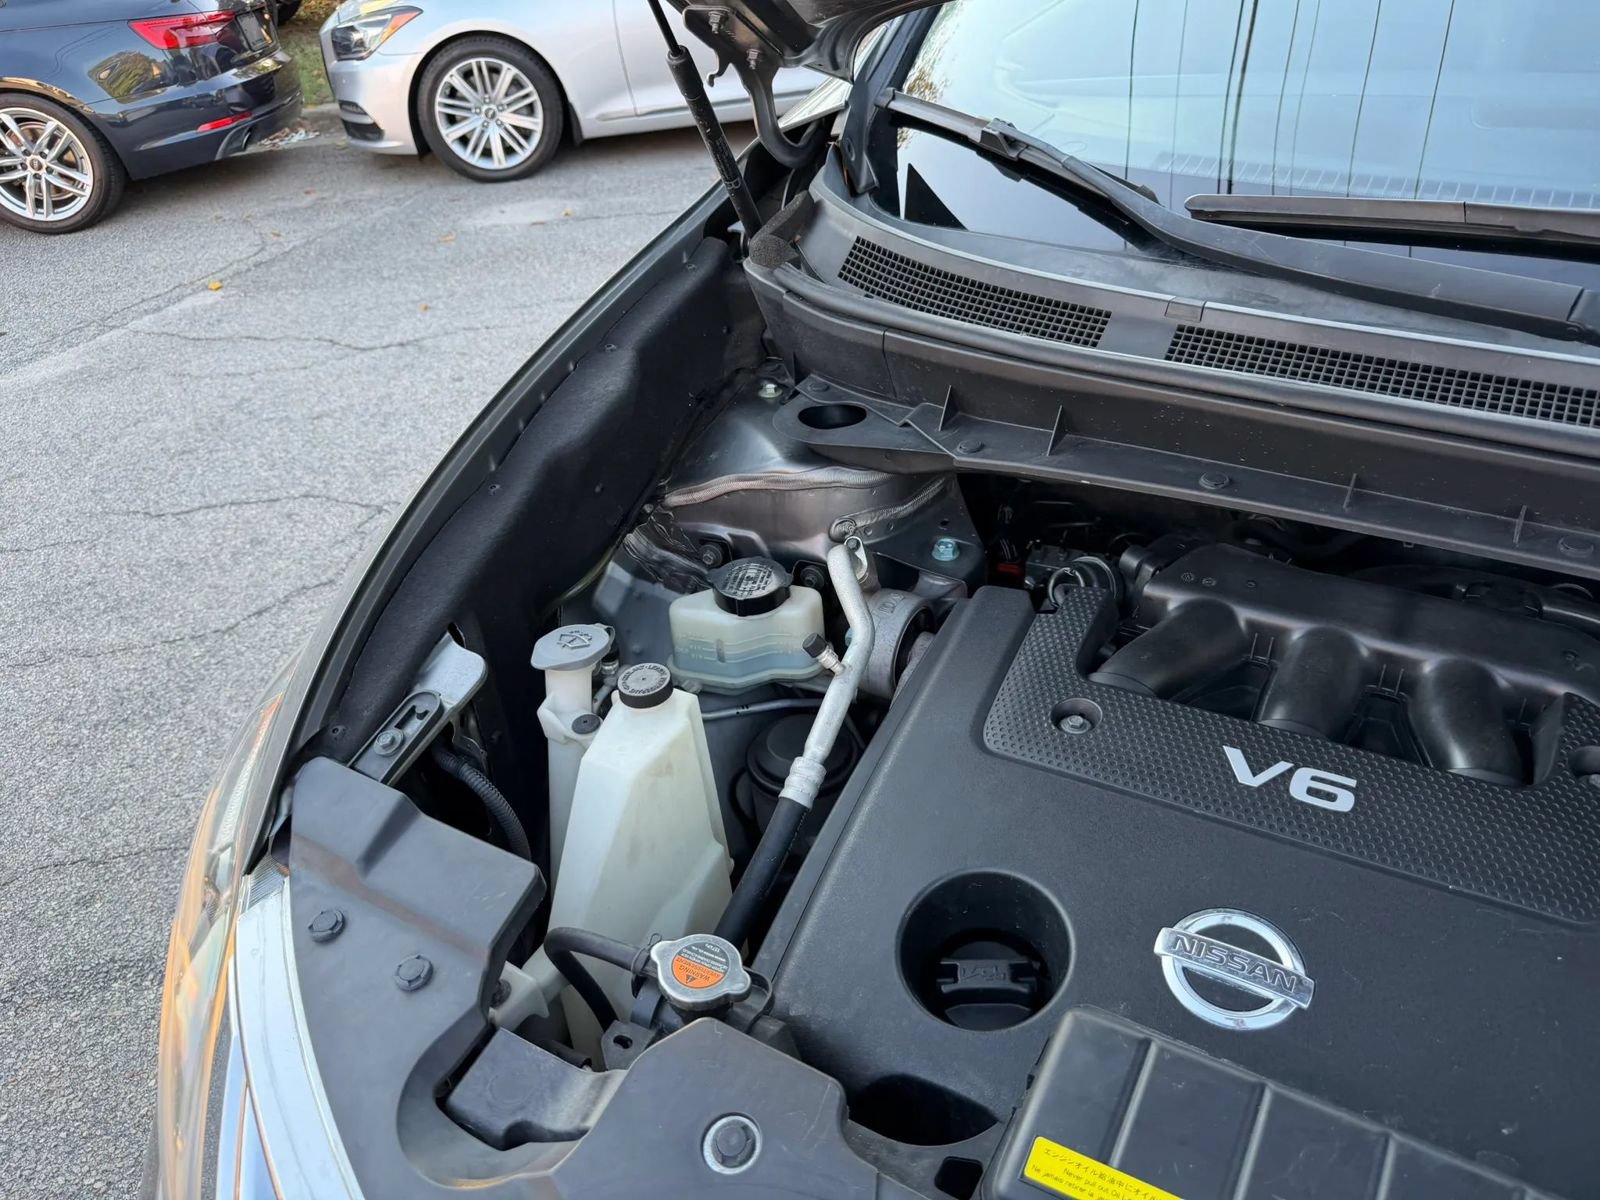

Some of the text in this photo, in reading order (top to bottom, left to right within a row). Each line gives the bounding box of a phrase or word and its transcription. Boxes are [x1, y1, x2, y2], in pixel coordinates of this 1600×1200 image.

[1222, 745, 1357, 812] V6
[678, 964, 710, 981] WARNING
[1171, 934, 1297, 993] NISSAN
